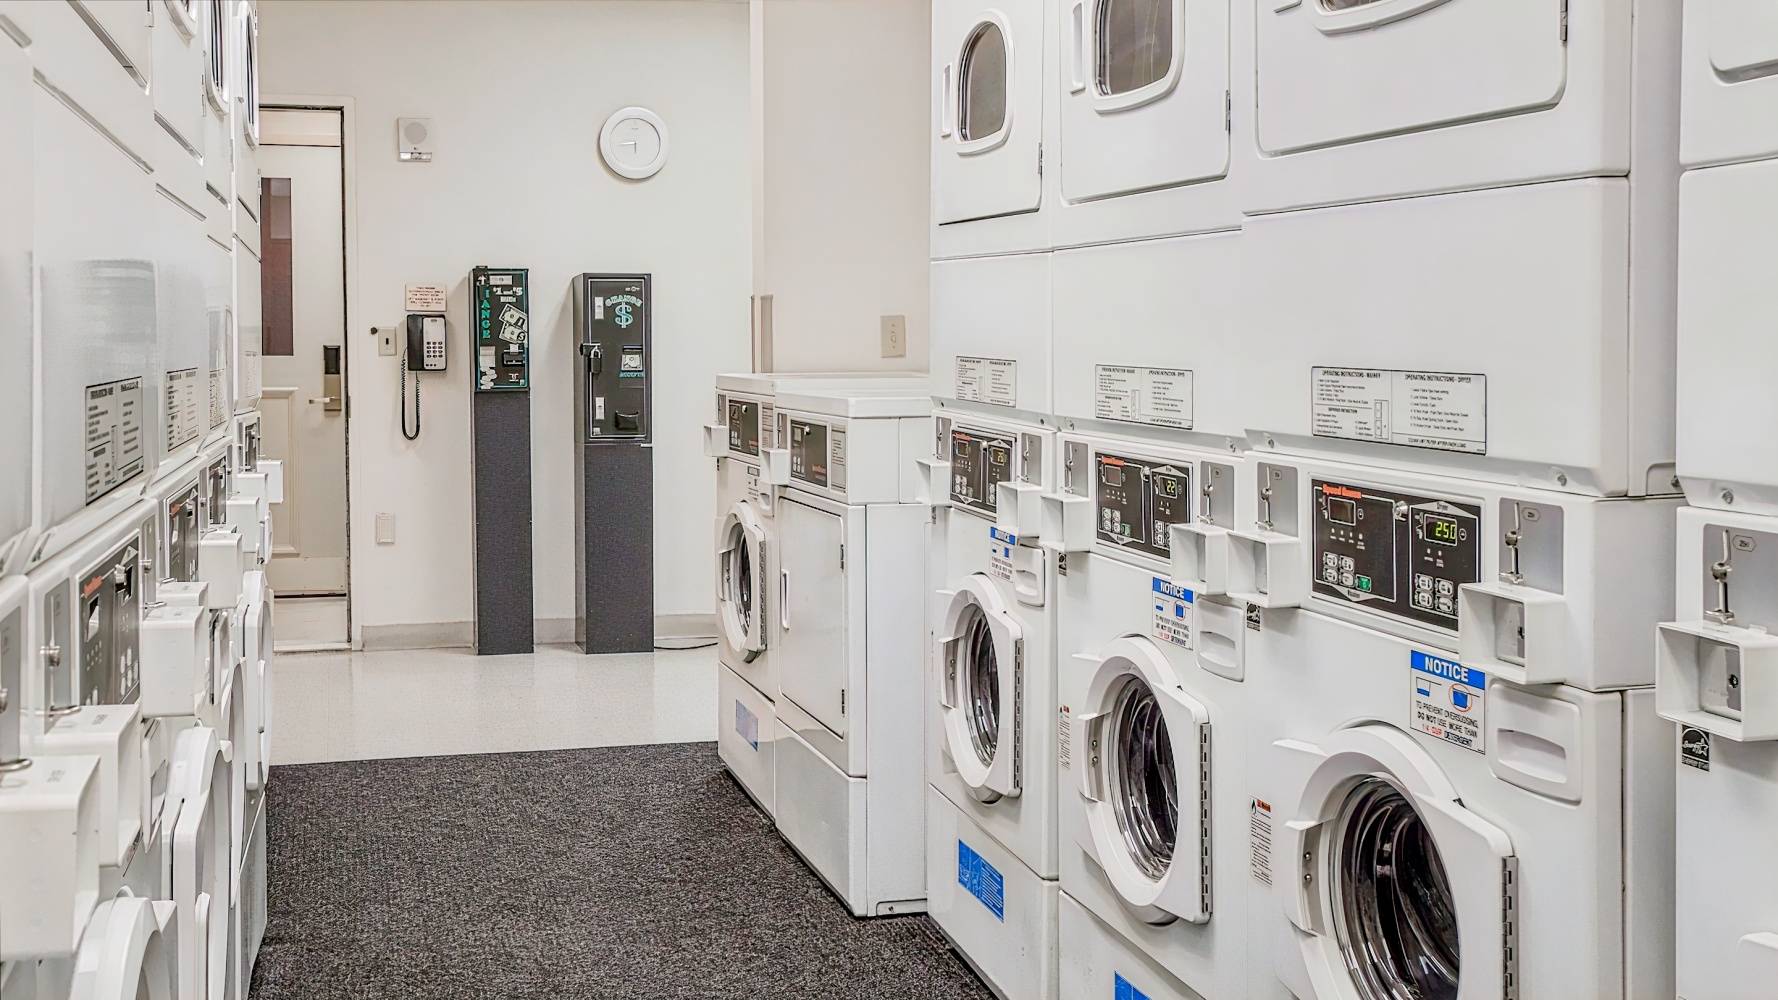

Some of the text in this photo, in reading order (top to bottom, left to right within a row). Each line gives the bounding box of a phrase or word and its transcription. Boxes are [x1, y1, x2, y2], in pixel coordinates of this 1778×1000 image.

[1159, 580, 1185, 599] NOTICE
[1424, 655, 1469, 682] NOTICE
[1425, 713, 1437, 724] NOT
